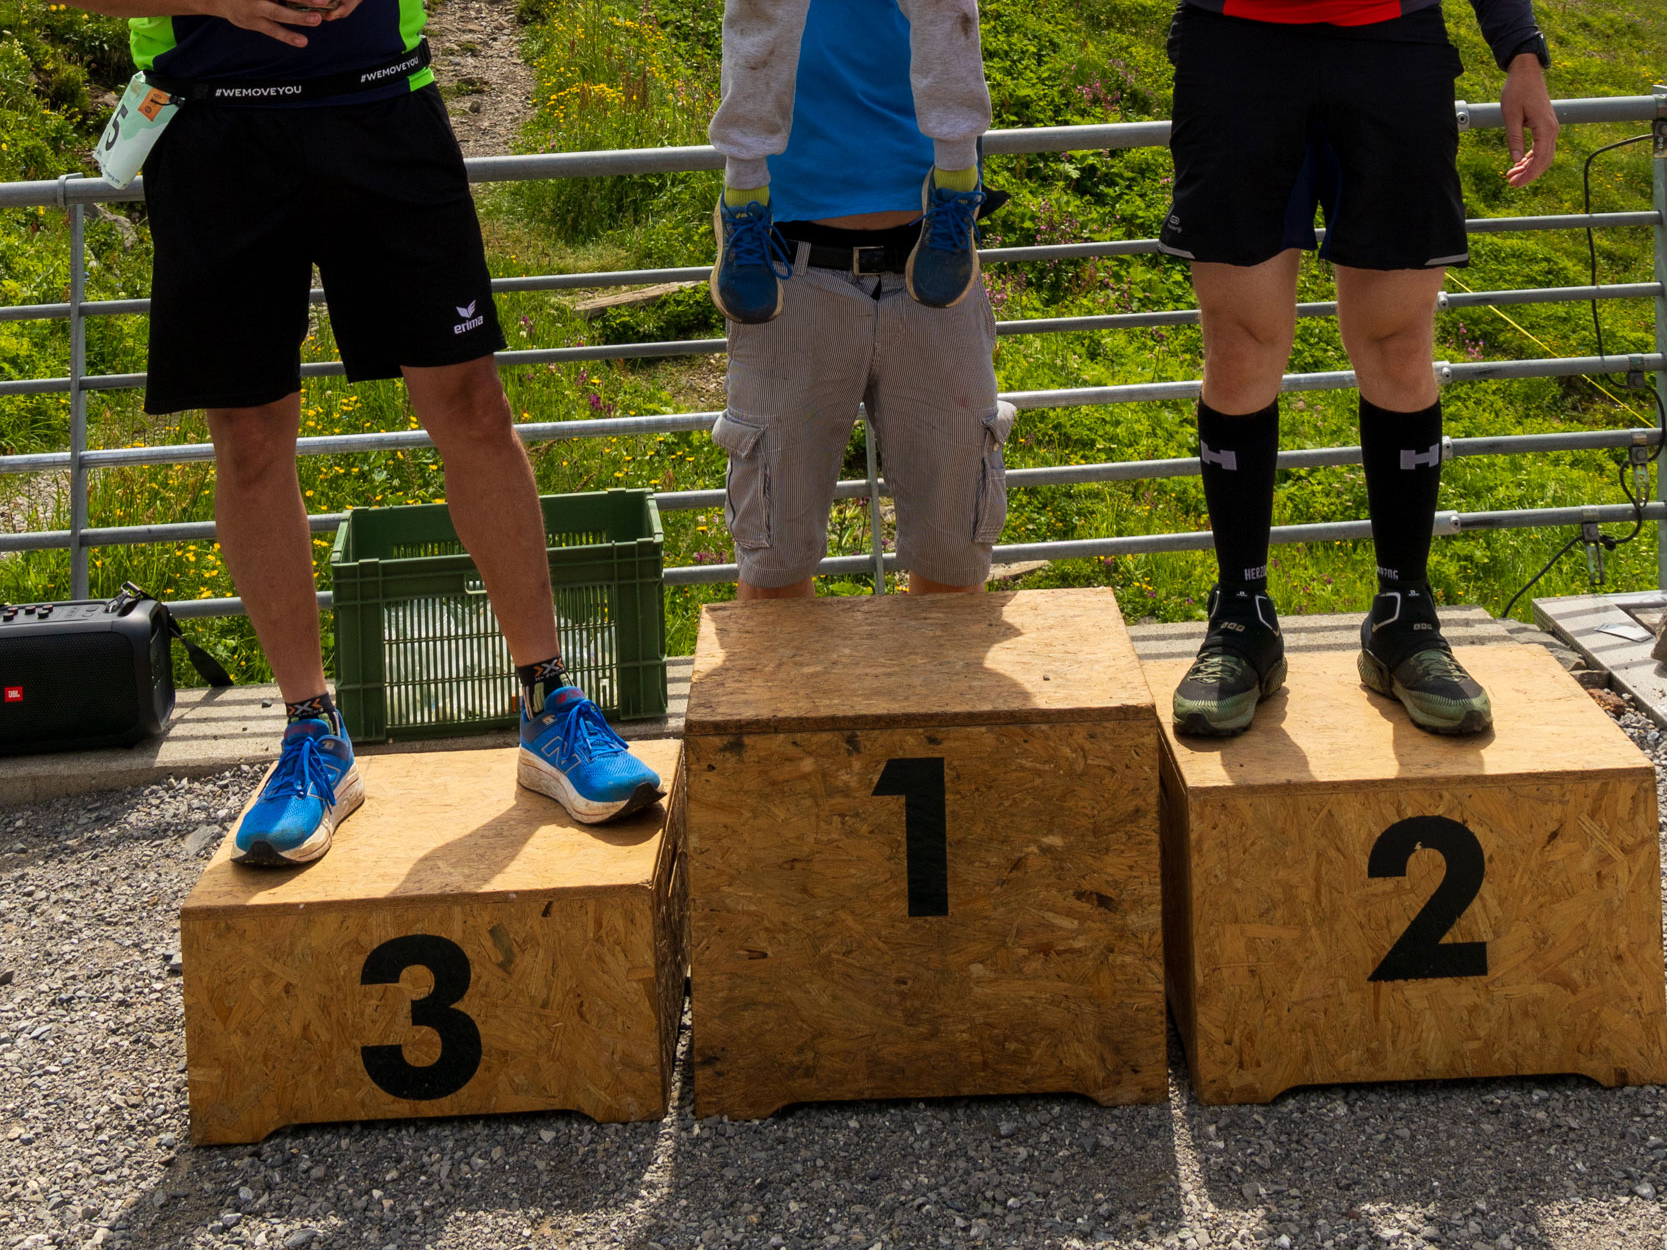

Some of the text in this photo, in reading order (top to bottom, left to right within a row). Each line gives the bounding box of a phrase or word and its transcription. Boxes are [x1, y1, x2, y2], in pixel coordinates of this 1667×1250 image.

[361, 56, 419, 83] #WEMOVEYOU
[215, 85, 302, 97] #WEMOVEYOU
[453, 315, 484, 334] erima
[8, 690, 20, 698] JBL
[871, 757, 949, 918] 1
[1367, 815, 1489, 982] 2
[361, 934, 482, 1100] 3
